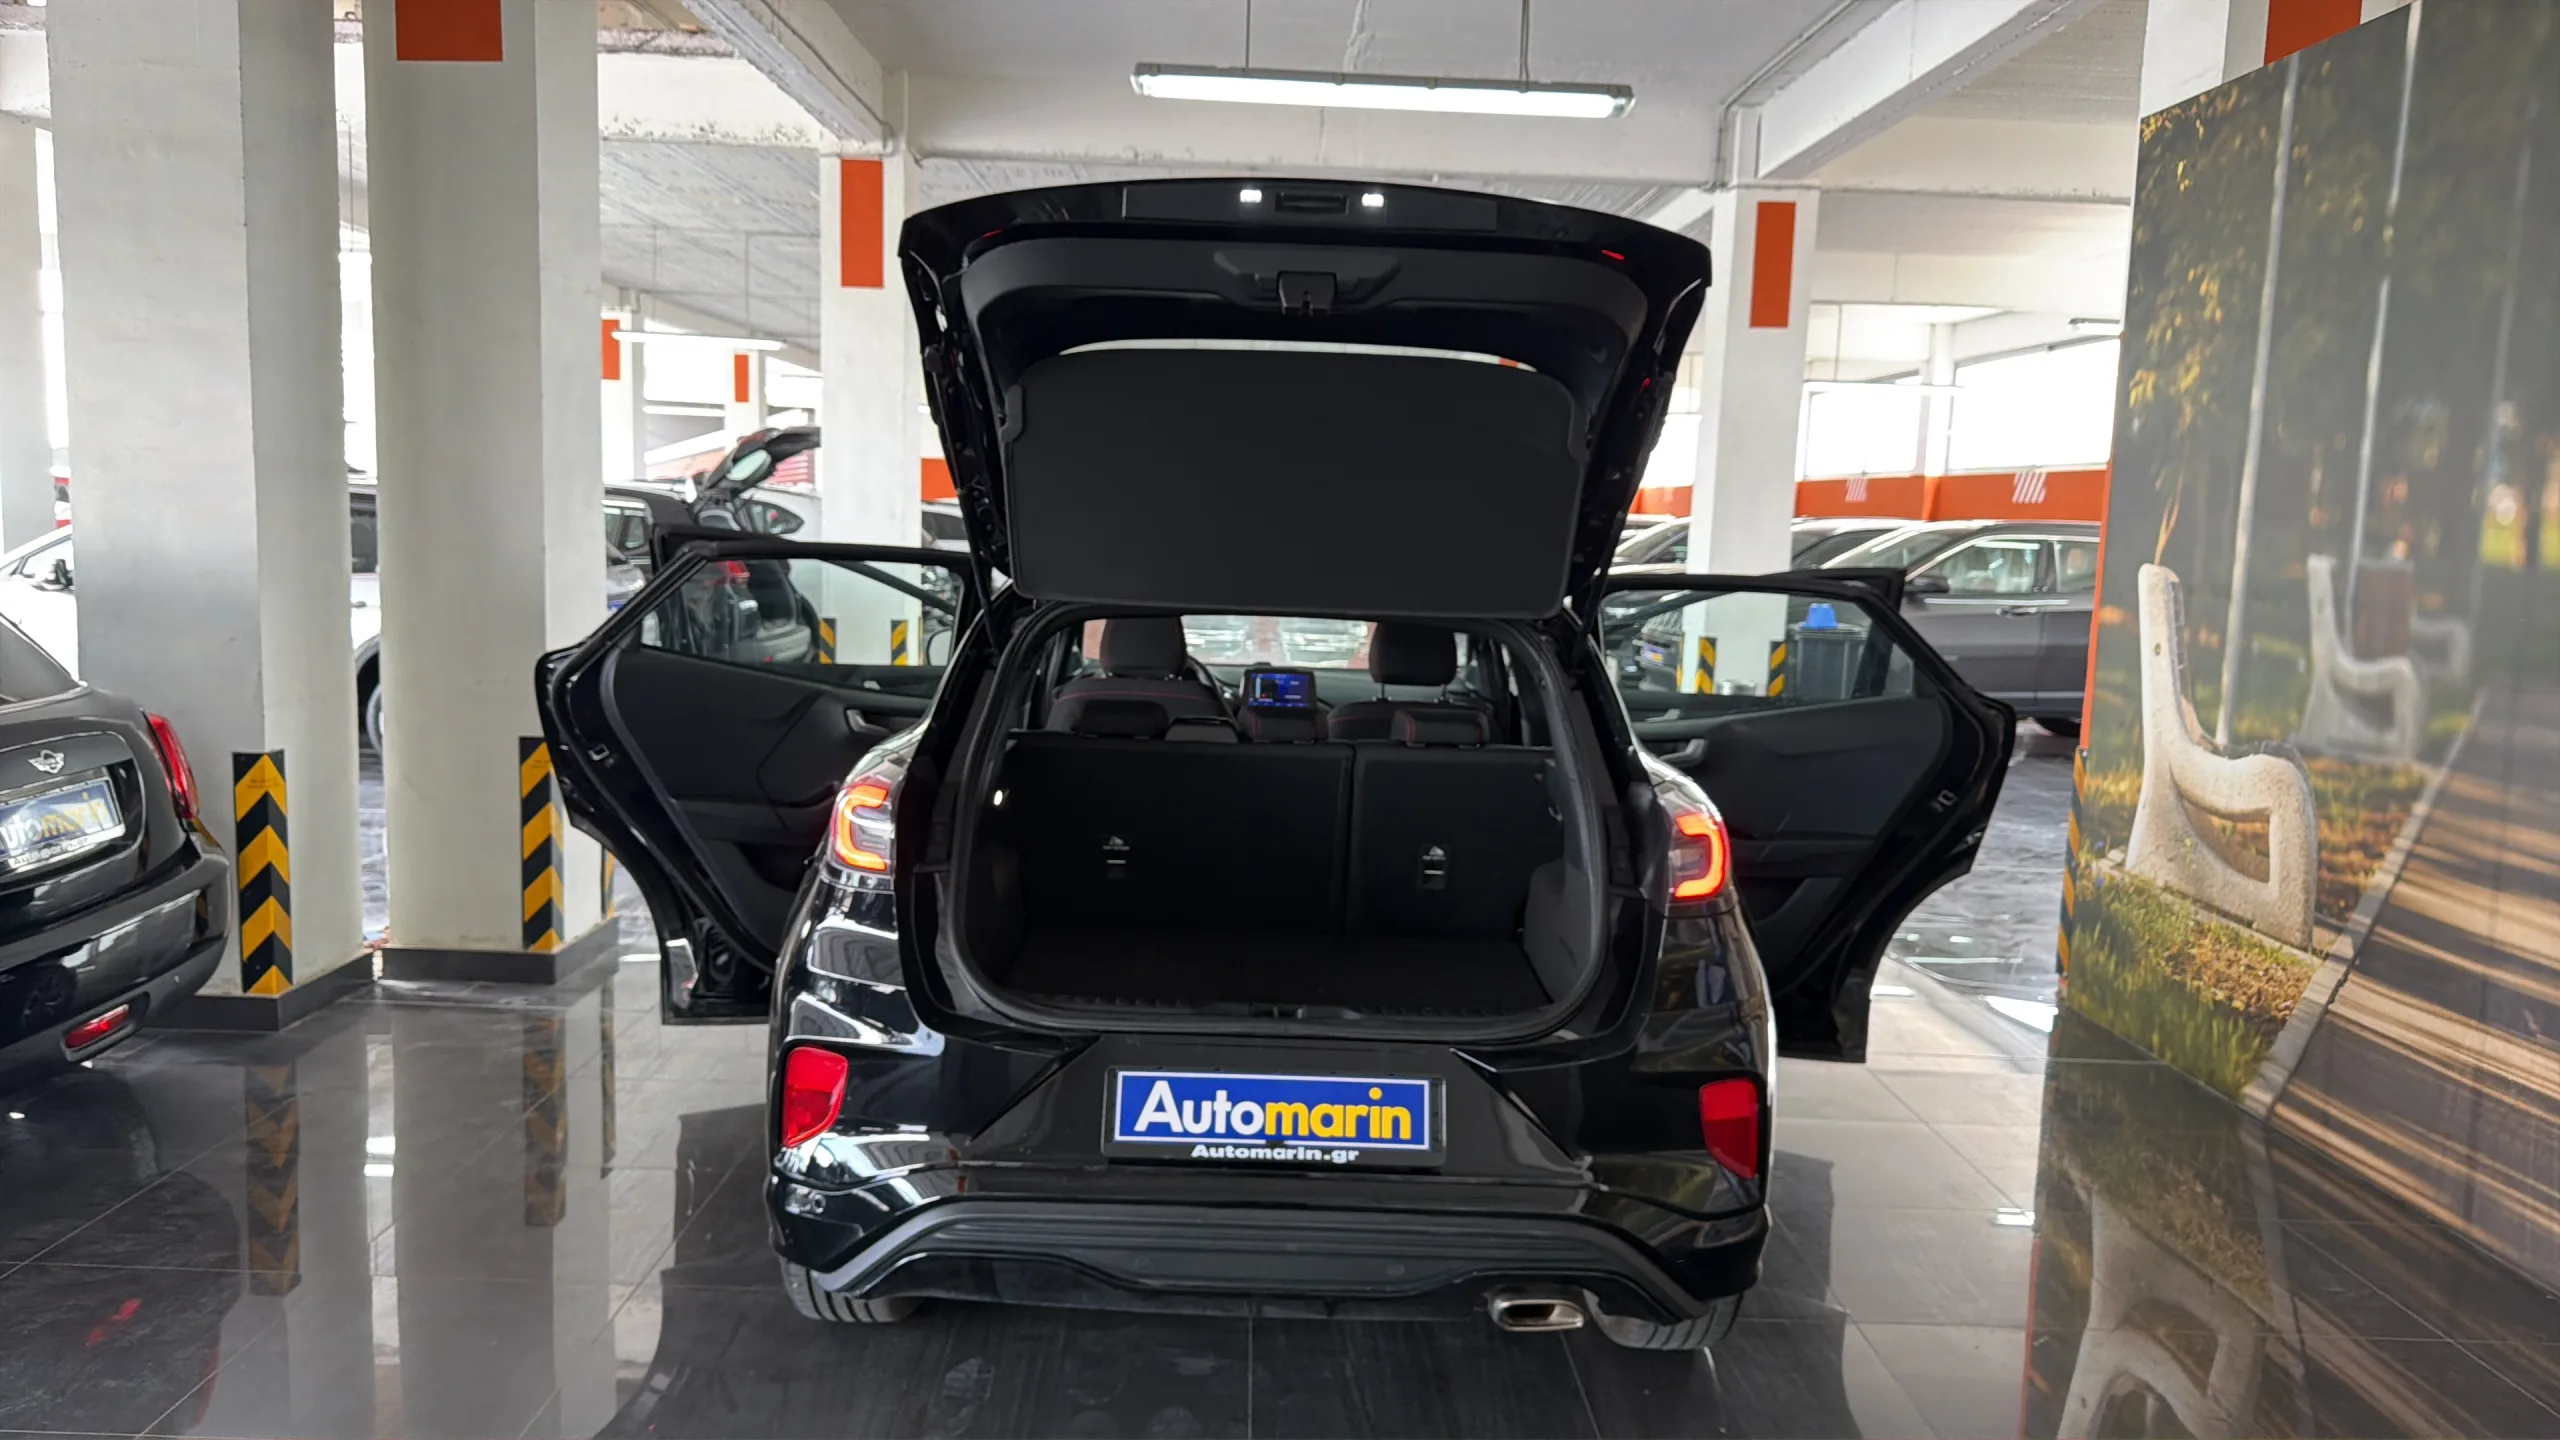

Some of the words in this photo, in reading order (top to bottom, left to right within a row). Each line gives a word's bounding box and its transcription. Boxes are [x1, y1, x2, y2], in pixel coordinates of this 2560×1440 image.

[0, 791, 112, 849] utomarin
[1134, 1080, 1412, 1139] Automarin
[1191, 1144, 1359, 1164] Automarin.gr
